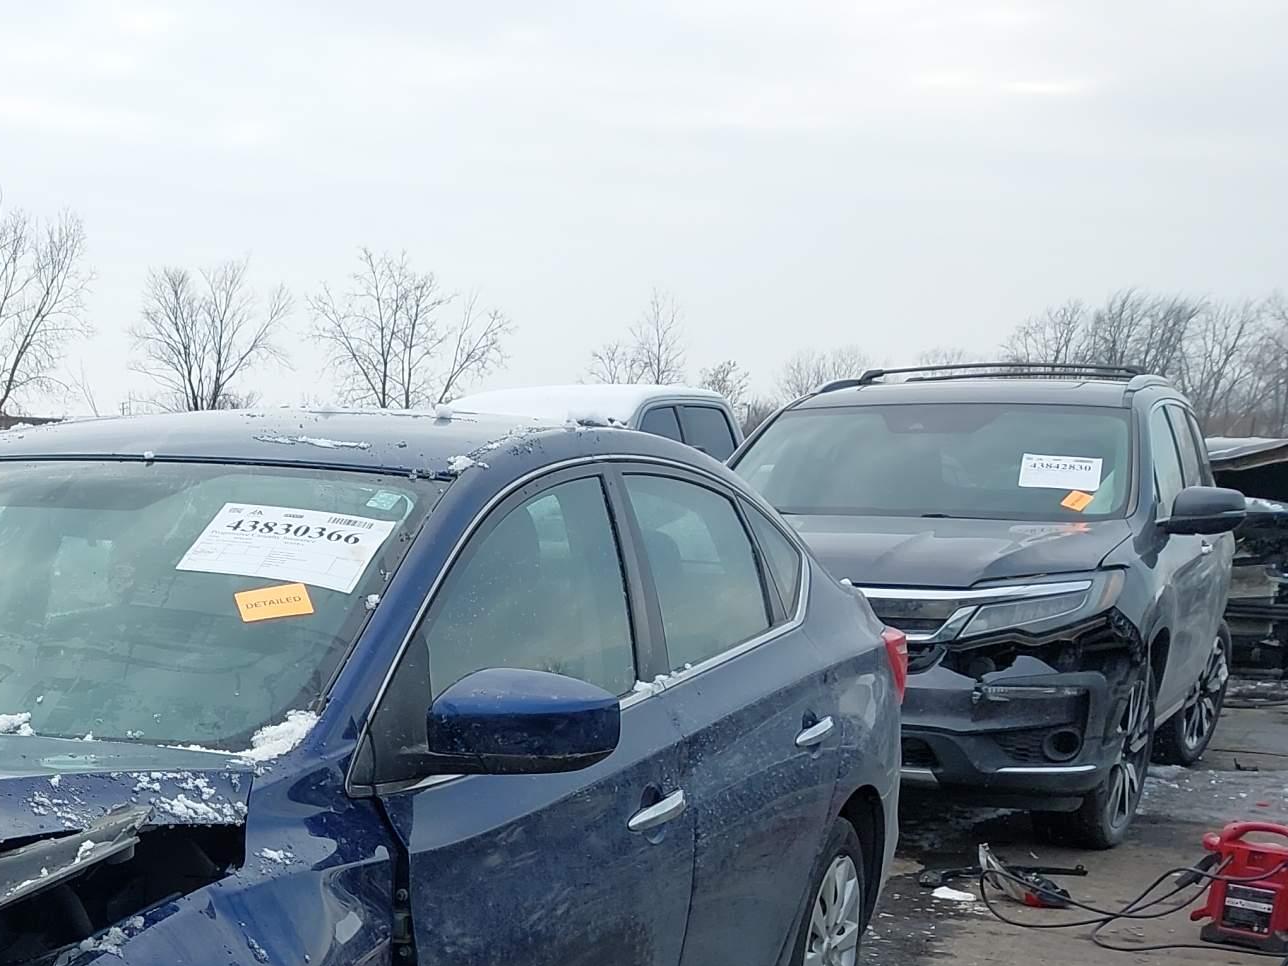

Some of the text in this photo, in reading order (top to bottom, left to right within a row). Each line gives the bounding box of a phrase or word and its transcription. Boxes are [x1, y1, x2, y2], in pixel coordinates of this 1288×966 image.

[1030, 462, 1092, 472] 43842830
[226, 519, 362, 545] 43830366
[245, 595, 302, 609] DETAILED
